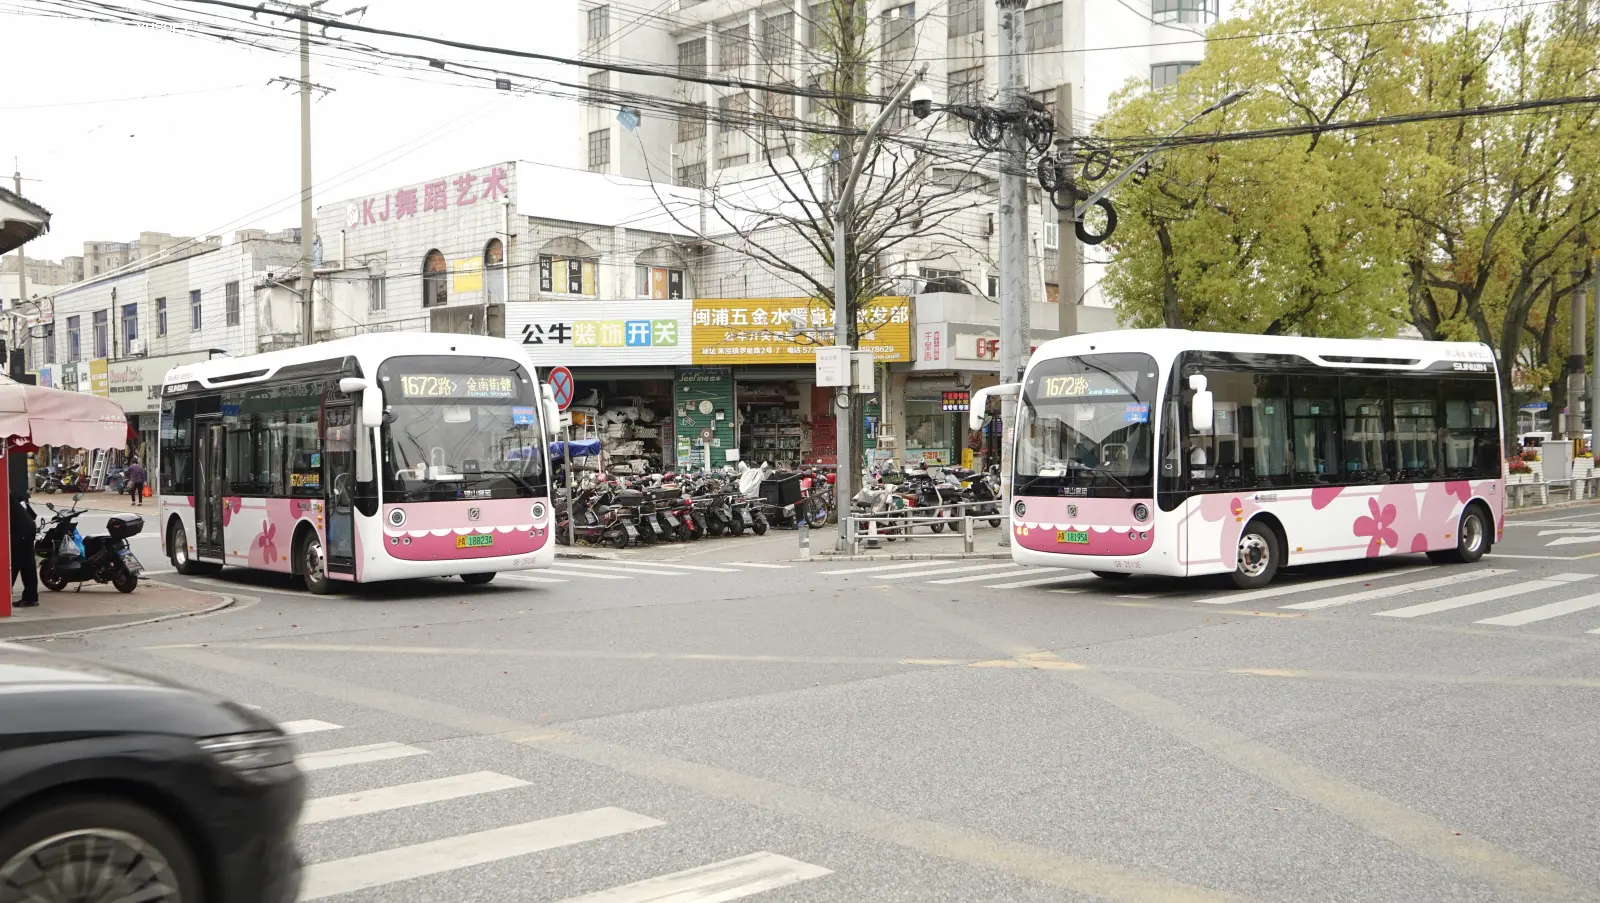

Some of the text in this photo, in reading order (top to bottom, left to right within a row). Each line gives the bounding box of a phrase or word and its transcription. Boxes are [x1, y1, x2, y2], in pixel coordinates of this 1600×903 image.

[362, 167, 509, 225] KJ舞蹈艺术
[692, 306, 909, 326] 闽浦五金水暖电批发部
[521, 322, 676, 344] 公牛装饰开关
[1453, 362, 1487, 371] SUNWIN
[401, 376, 452, 396] 1672路
[1046, 376, 1087, 396] 1672路
